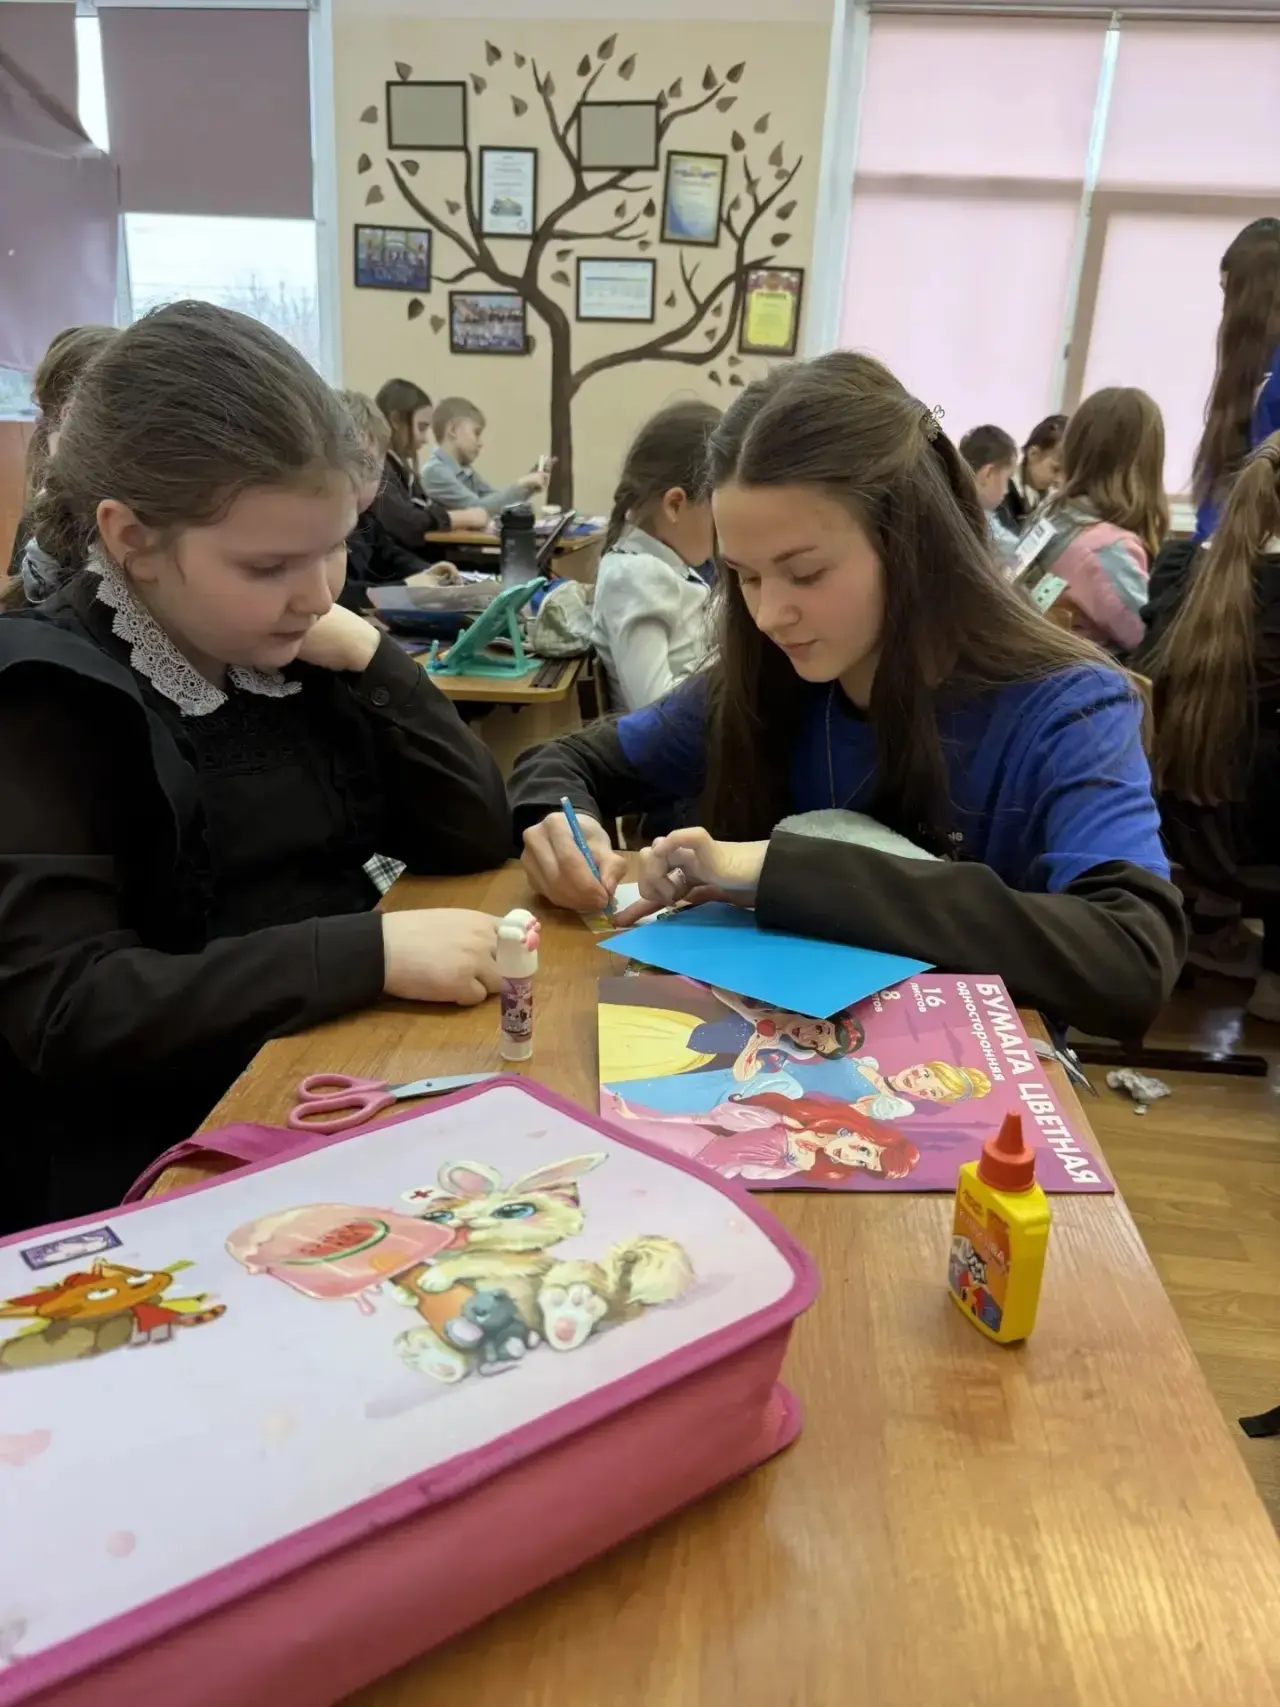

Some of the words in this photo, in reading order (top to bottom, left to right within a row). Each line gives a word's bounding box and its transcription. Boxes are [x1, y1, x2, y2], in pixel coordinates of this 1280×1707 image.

[880, 989, 901, 1000] 8
[922, 987, 946, 1007] 16
[956, 981, 1005, 1082] односторонняя
[975, 982, 1036, 1075] БУМАГА
[1018, 1083, 1101, 1184] ЦВЕТНАЯ
